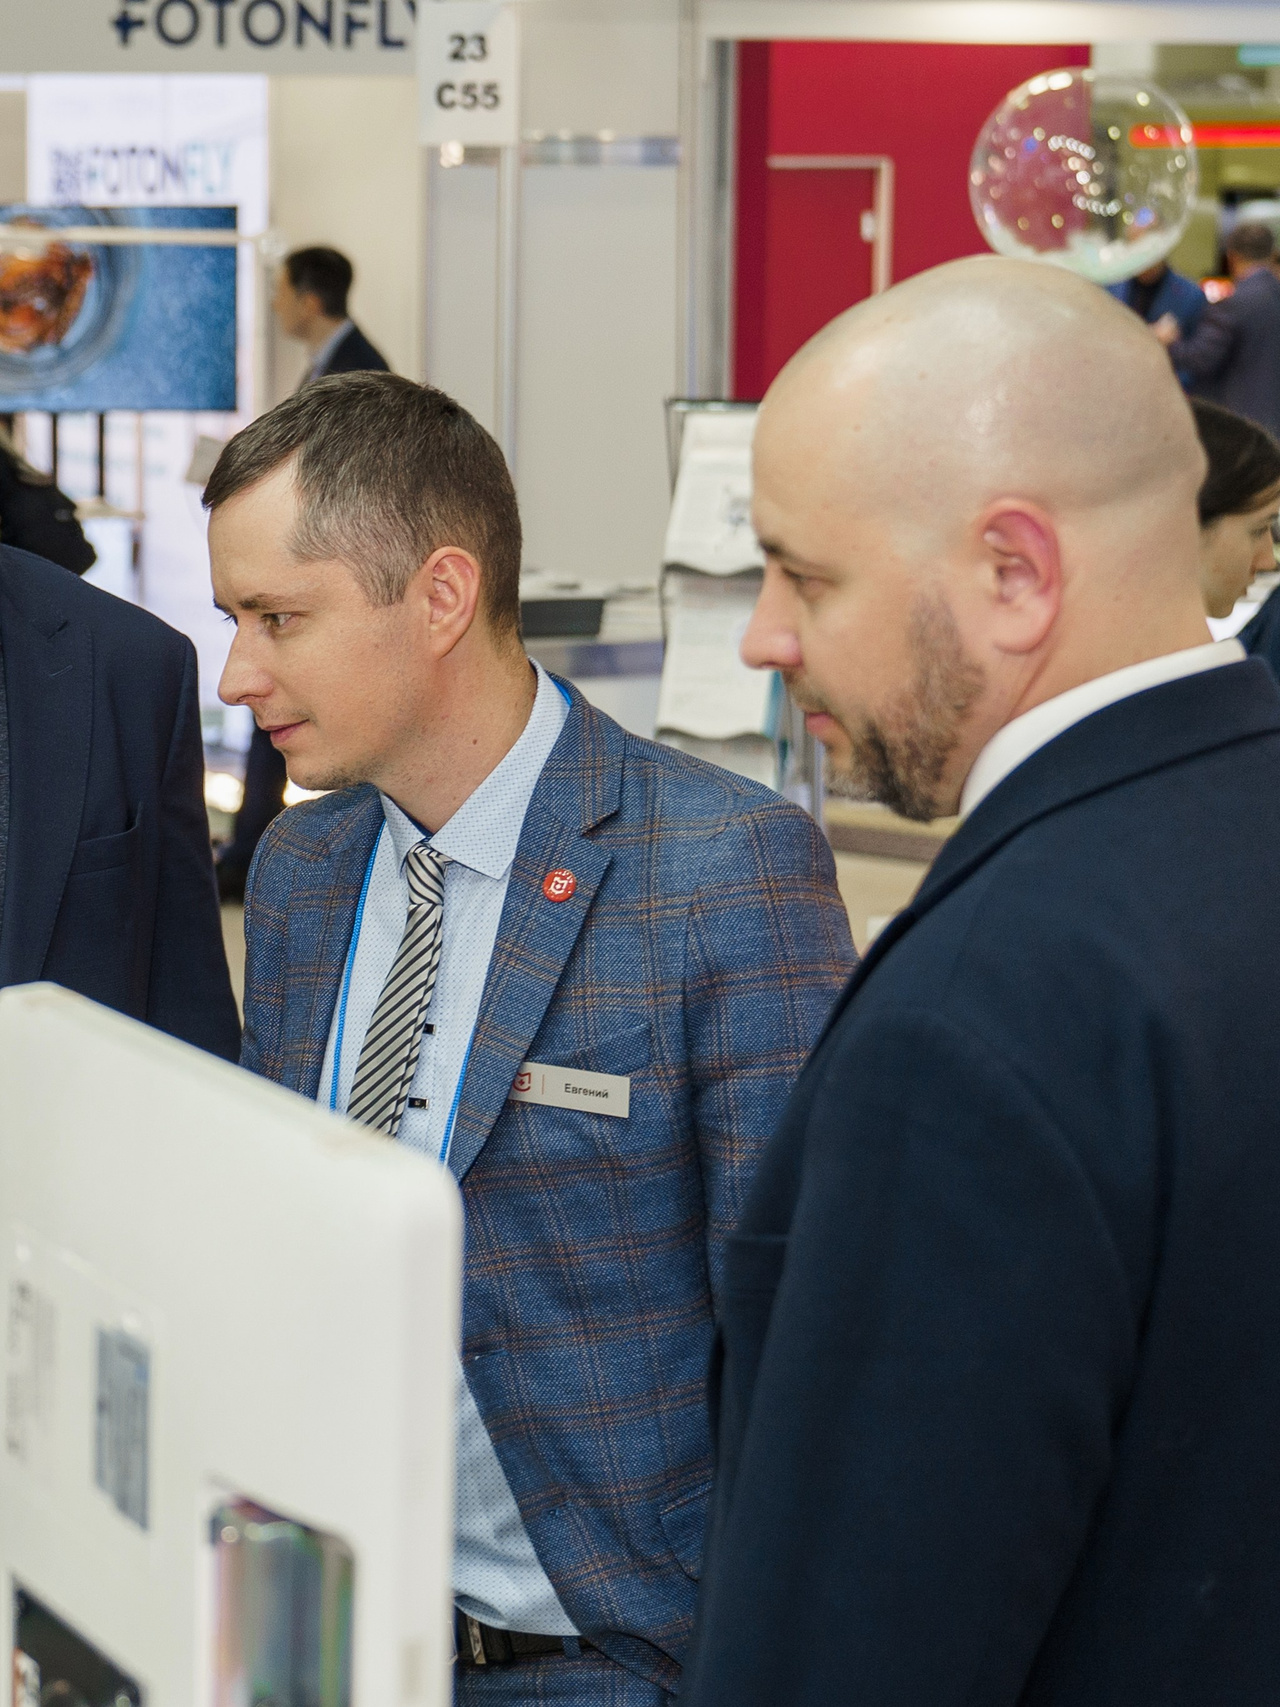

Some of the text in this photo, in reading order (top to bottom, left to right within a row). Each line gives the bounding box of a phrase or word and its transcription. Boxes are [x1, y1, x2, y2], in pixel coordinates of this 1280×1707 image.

[111, 0, 417, 48] FOTONFL
[449, 33, 489, 62] 23
[435, 82, 501, 110] C55
[564, 1083, 609, 1099] Евгений
